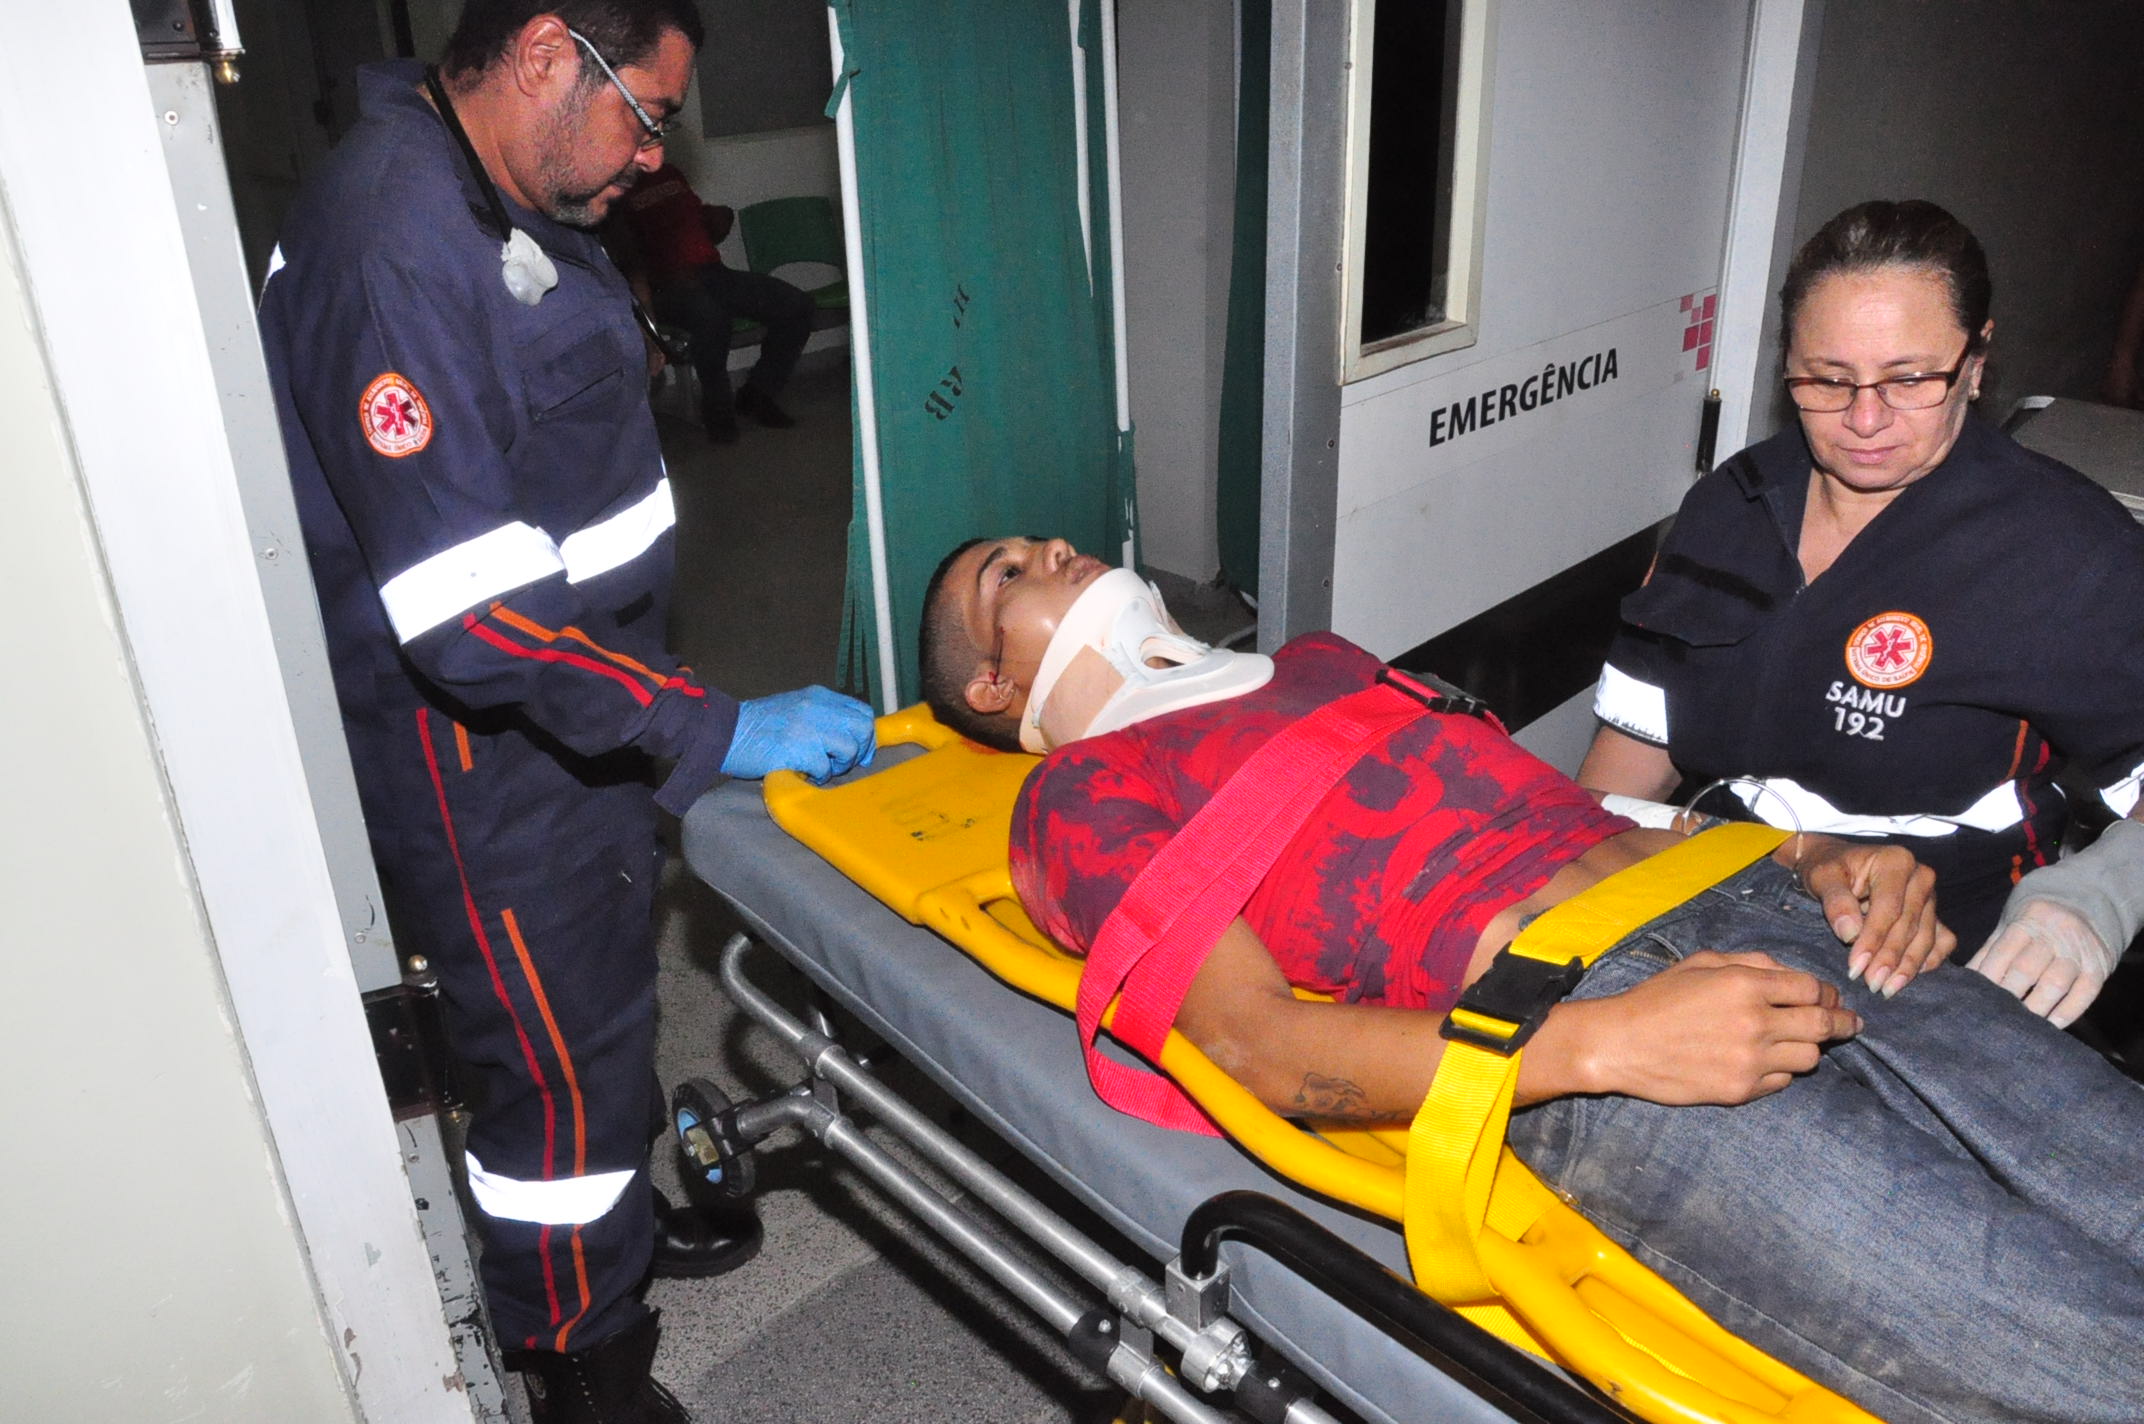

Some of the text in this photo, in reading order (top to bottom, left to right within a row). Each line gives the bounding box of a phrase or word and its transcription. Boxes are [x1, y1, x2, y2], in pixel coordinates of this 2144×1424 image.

[1429, 348, 1618, 447] EMERGÊNCIA
[1825, 681, 1907, 717] SAMU
[1834, 707, 1884, 741] 192
